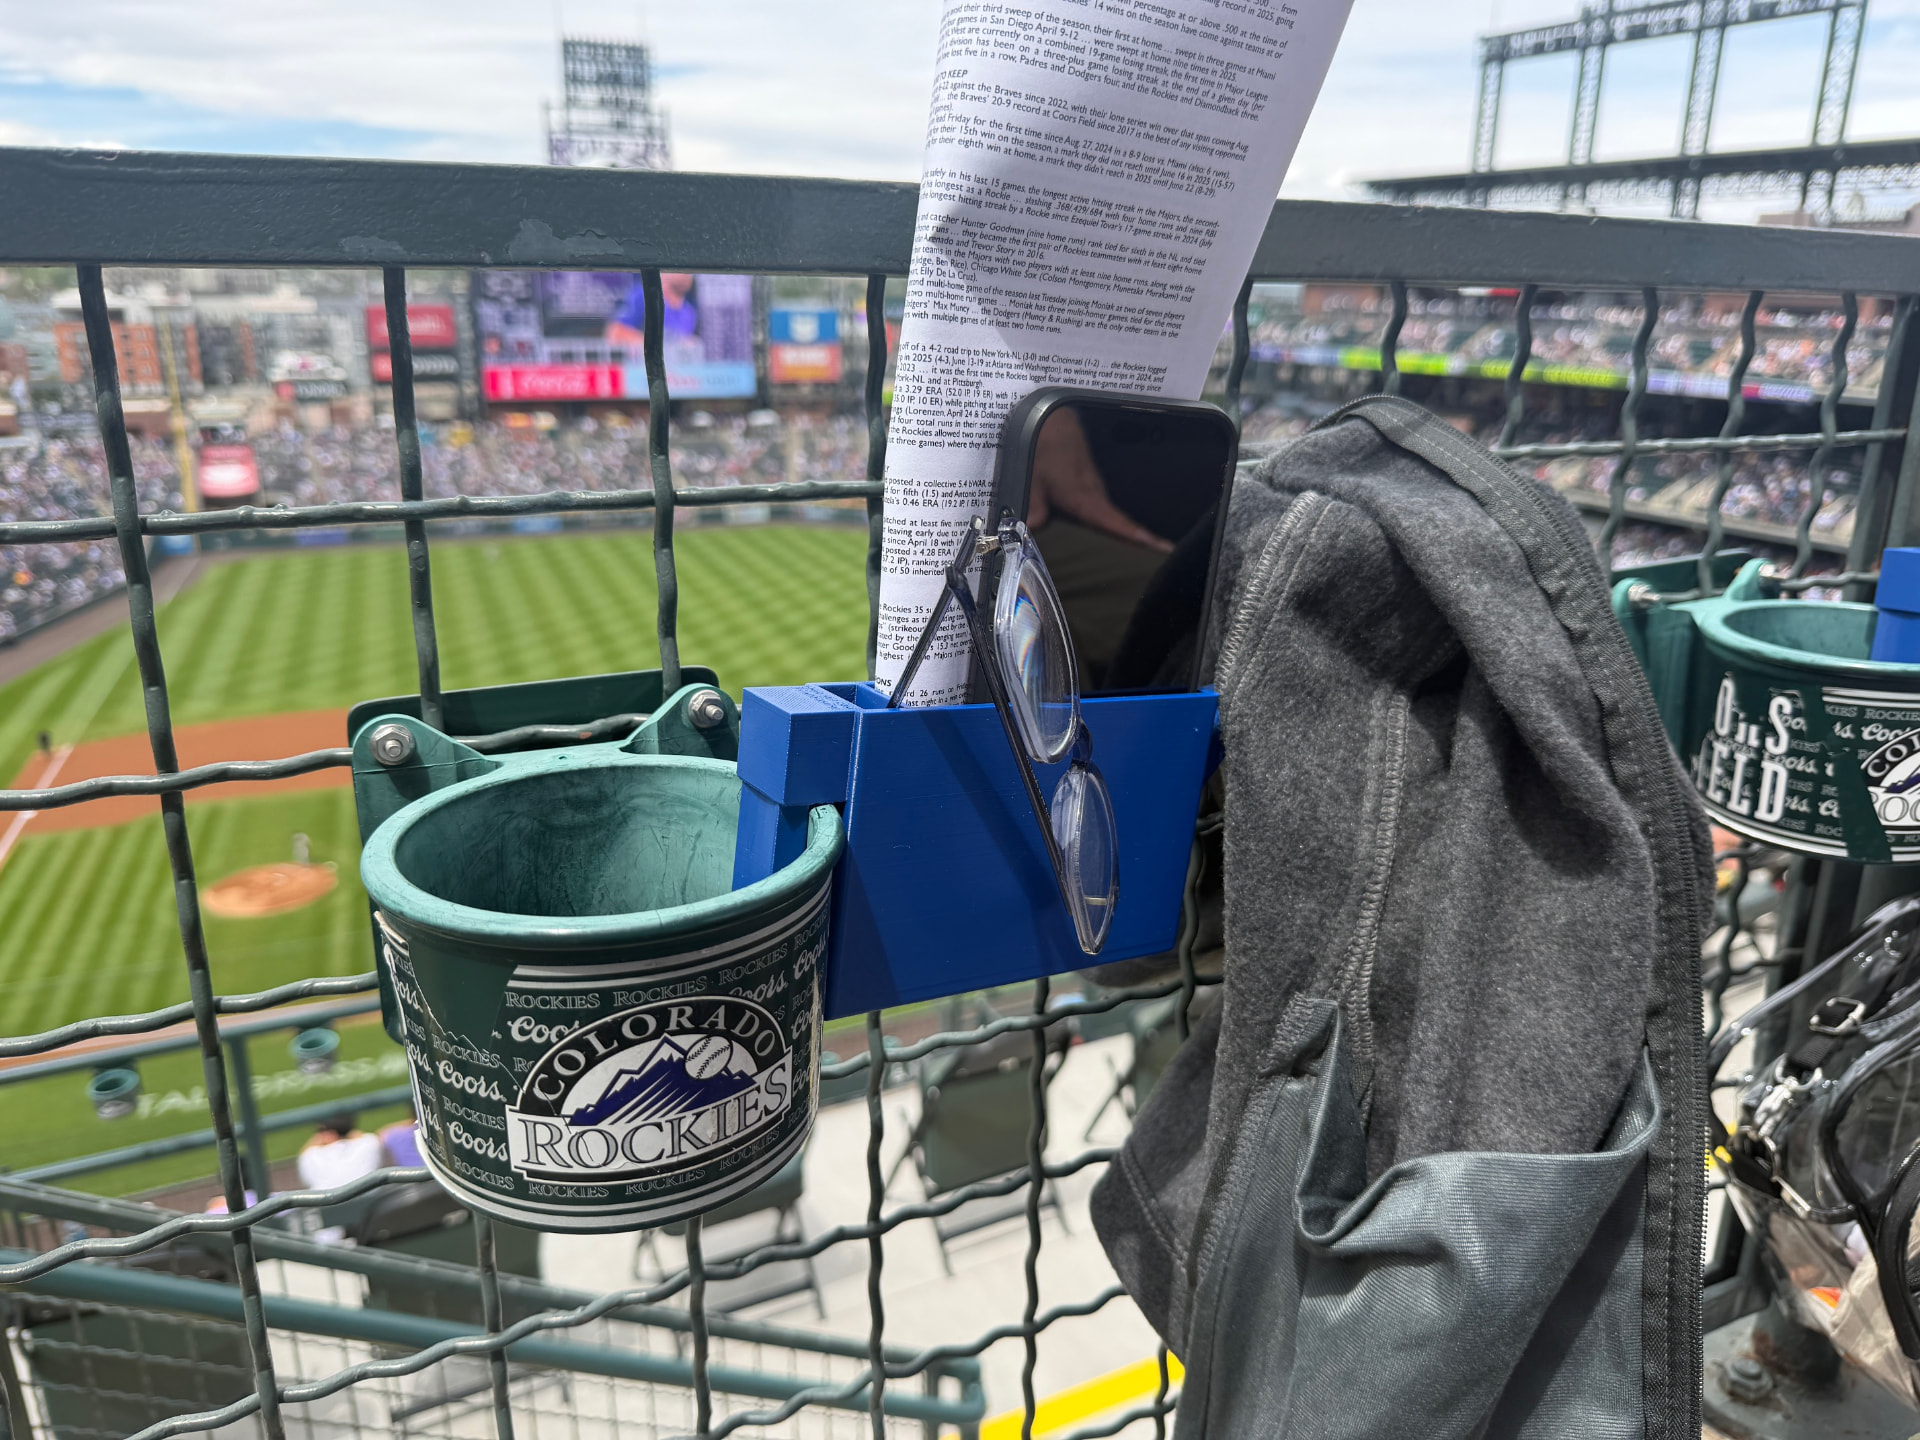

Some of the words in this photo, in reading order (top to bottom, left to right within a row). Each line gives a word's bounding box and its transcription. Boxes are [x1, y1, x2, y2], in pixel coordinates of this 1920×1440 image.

[1222, 2, 1246, 13] record
[1248, 7, 1255, 15] in
[1276, 16, 1295, 30] going
[1281, 5, 1298, 16] from
[1133, 2, 1176, 18] percentage
[1178, 13, 1186, 21] at
[1200, 18, 1221, 31] above
[1223, 24, 1238, 35] .500
[1240, 29, 1247, 38] at
[1249, 31, 1261, 42] the
[1263, 34, 1278, 46] time
[1279, 39, 1288, 49] of
[964, 3, 981, 13] their
[983, 4, 1003, 14] third
[1004, 8, 1032, 20] sweep
[1035, 11, 1044, 20] of
[1046, 13, 1060, 24] the
[1093, 25, 1113, 37] their
[1115, 30, 1130, 42] first
[1132, 35, 1140, 44] at
[1141, 38, 1163, 51] home
[1175, 47, 1197, 60] swept
[1198, 52, 1206, 61] in
[1206, 55, 1225, 67] three
[1225, 61, 1247, 75] games
[1248, 66, 1255, 75] at
[1256, 68, 1277, 81] Miami
[947, 69, 968, 78] KEEP
[951, 49, 962, 57] lost
[964, 47, 978, 56] five
[980, 49, 987, 57] in
[1020, 55, 1048, 69] Padres
[1051, 62, 1065, 74] and
[1067, 68, 1101, 82] Dodgers
[1122, 80, 1135, 91] and
[1137, 84, 1149, 95] the
[1152, 87, 1178, 102] Rockies
[1180, 95, 1193, 105] and
[1195, 97, 1240, 117] Diamondback
[950, 82, 975, 93] against
[978, 83, 992, 93] the
[994, 85, 1022, 99] Braves
[1025, 93, 1046, 104] since
[1071, 104, 1088, 114] with
[1089, 107, 1108, 118] their
[1109, 112, 1125, 123] lone
[1127, 117, 1147, 129] series
[1149, 122, 1161, 132] win
[1163, 126, 1179, 136] over
[1180, 129, 1194, 139] that
[1195, 133, 1211, 144] span
[1211, 137, 1235, 150] coming
[930, 214, 959, 225] catcher
[961, 217, 987, 229] Hunter
[989, 223, 1025, 235] Goodman
[1026, 228, 1044, 239] (nine
[1046, 232, 1067, 243] home
[1068, 235, 1086, 246] runs)
[1088, 239, 1103, 250] rank
[1104, 241, 1118, 251] tied
[1119, 244, 1130, 253] for
[1131, 246, 1147, 257] sixth
[1148, 250, 1155, 258] in
[1156, 251, 1167, 260] the
[1169, 254, 1178, 262] NL
[1180, 256, 1192, 265] and
[1194, 258, 1206, 267] tied
[920, 267, 935, 278] Elly
[936, 269, 947, 278] De
[948, 270, 956, 279] La
[912, 311, 929, 320] with
[931, 313, 959, 324] multiple
[960, 316, 978, 325] games
[980, 318, 987, 326] of
[988, 319, 994, 327] at
[995, 320, 1011, 329] least
[1012, 322, 1024, 330] two
[1026, 323, 1045, 332] home
[905, 385, 923, 394] 3.29
[926, 387, 943, 395] ERA
[982, 390, 993, 399] ER)
[944, 378, 951, 386] at
[902, 428, 932, 436] Rockies
[935, 429, 960, 438] allowed
[889, 478, 913, 487] posted
[969, 480, 986, 488] bWAR
[890, 566, 898, 574] of
[882, 603, 912, 613] Rockies
[934, 652, 953, 660] Majors
[905, 699, 918, 707] last
[921, 699, 937, 707] night
[920, 689, 928, 697] 26
[504, 991, 601, 1010] ROCKIES
[612, 975, 708, 1007] ROCKIES
[718, 942, 789, 986] ROCKIES
[431, 1033, 501, 1069] ROCKIES
[532, 1004, 776, 1102] COLORADO
[436, 1060, 508, 1103] Coors
[442, 1095, 506, 1131] ROCKIES
[517, 1061, 788, 1169] ROCKIES
[446, 1121, 509, 1162] Coors
[452, 1155, 515, 1190] ROCKIES
[528, 1182, 610, 1198] ROCKIES
[625, 1167, 706, 1196] ROCKIES
